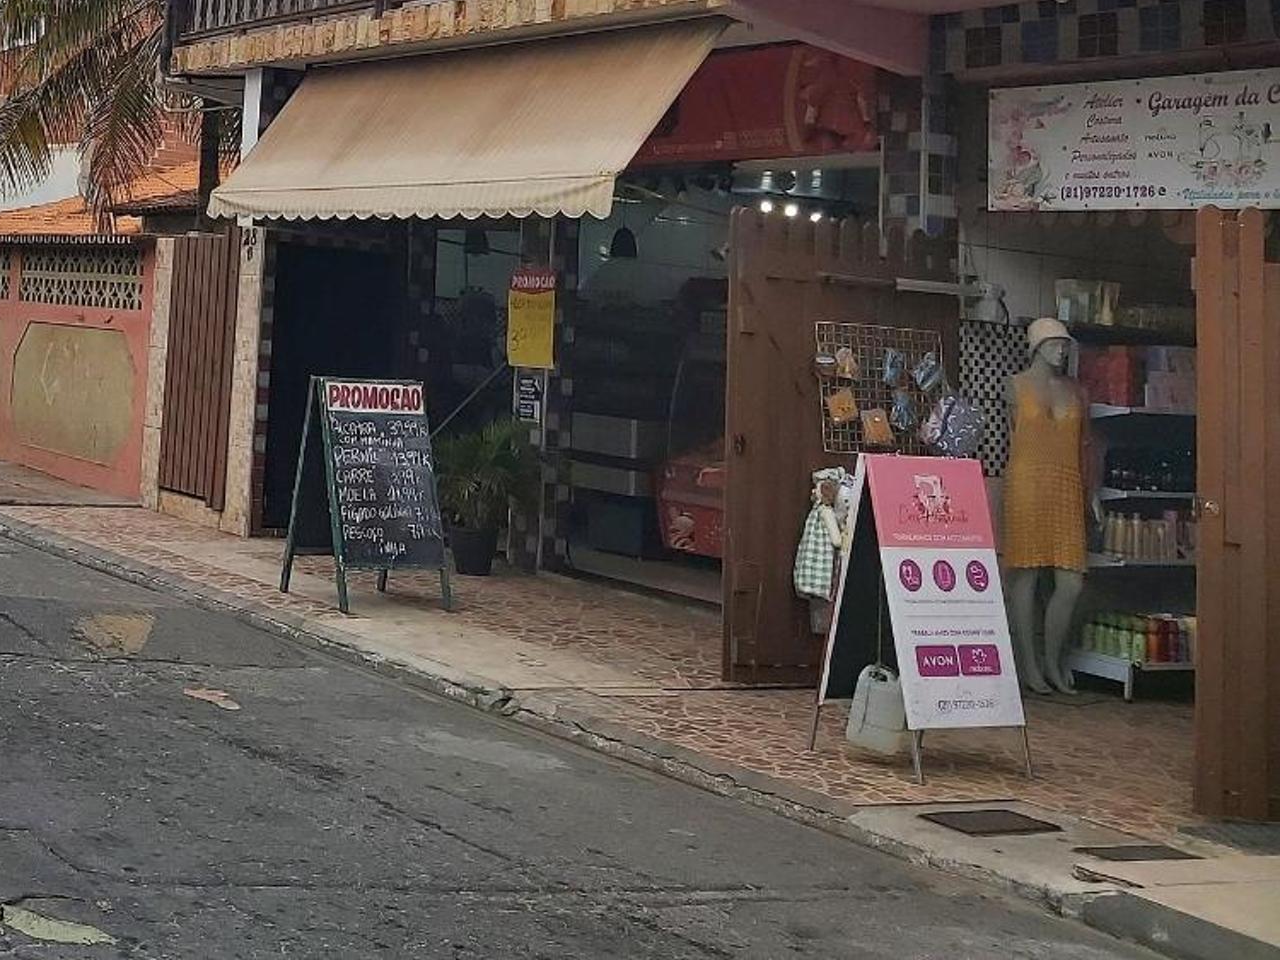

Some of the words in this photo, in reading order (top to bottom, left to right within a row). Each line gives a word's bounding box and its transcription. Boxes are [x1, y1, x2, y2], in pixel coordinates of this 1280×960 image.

[1148, 90, 1229, 117] Garagem
[1235, 85, 1261, 106] da
[922, 655, 954, 667] AVON
